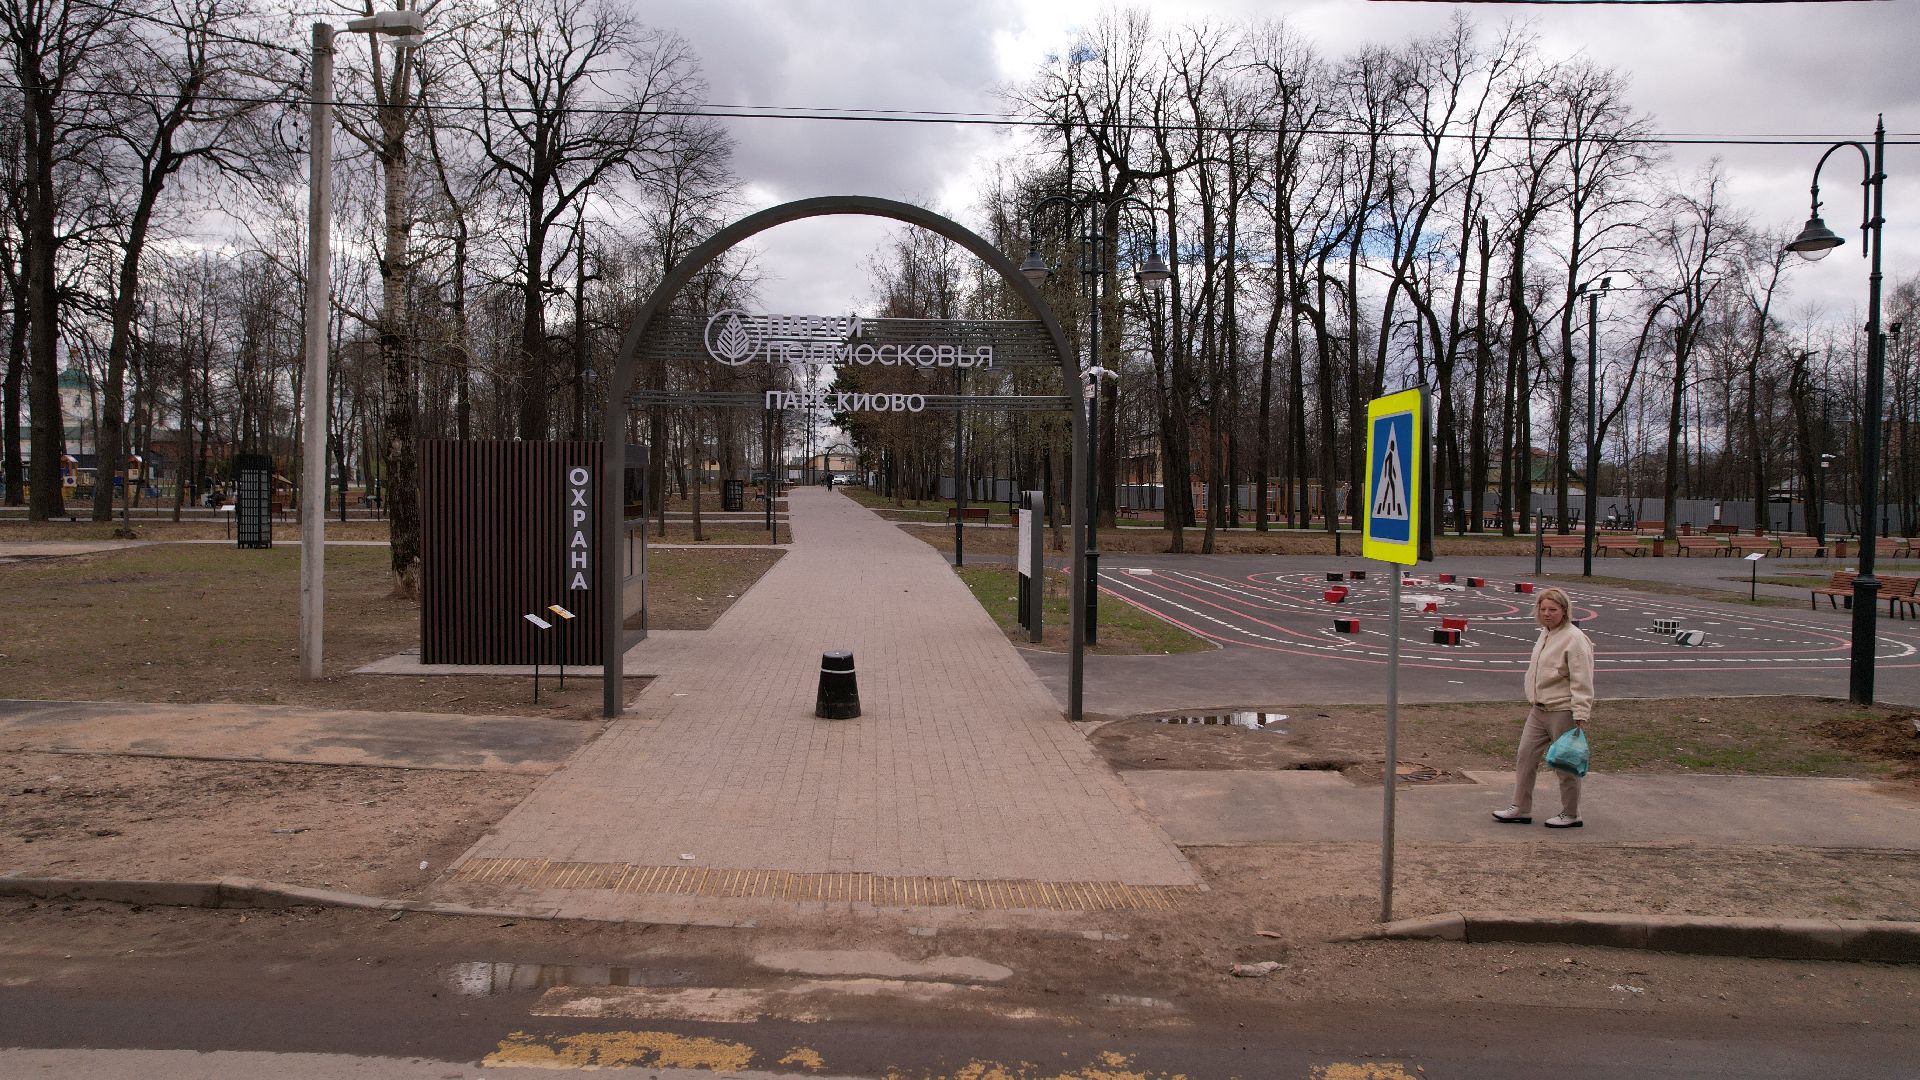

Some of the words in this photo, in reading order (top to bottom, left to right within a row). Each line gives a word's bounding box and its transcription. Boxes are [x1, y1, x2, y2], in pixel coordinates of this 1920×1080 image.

[767, 314, 863, 338] ПАРКИ
[766, 341, 993, 367] ПОДМОСКОВЬЯ
[766, 391, 830, 411] ПАРК
[837, 392, 925, 412] КИОВО
[569, 467, 588, 590] ОХРАНА
